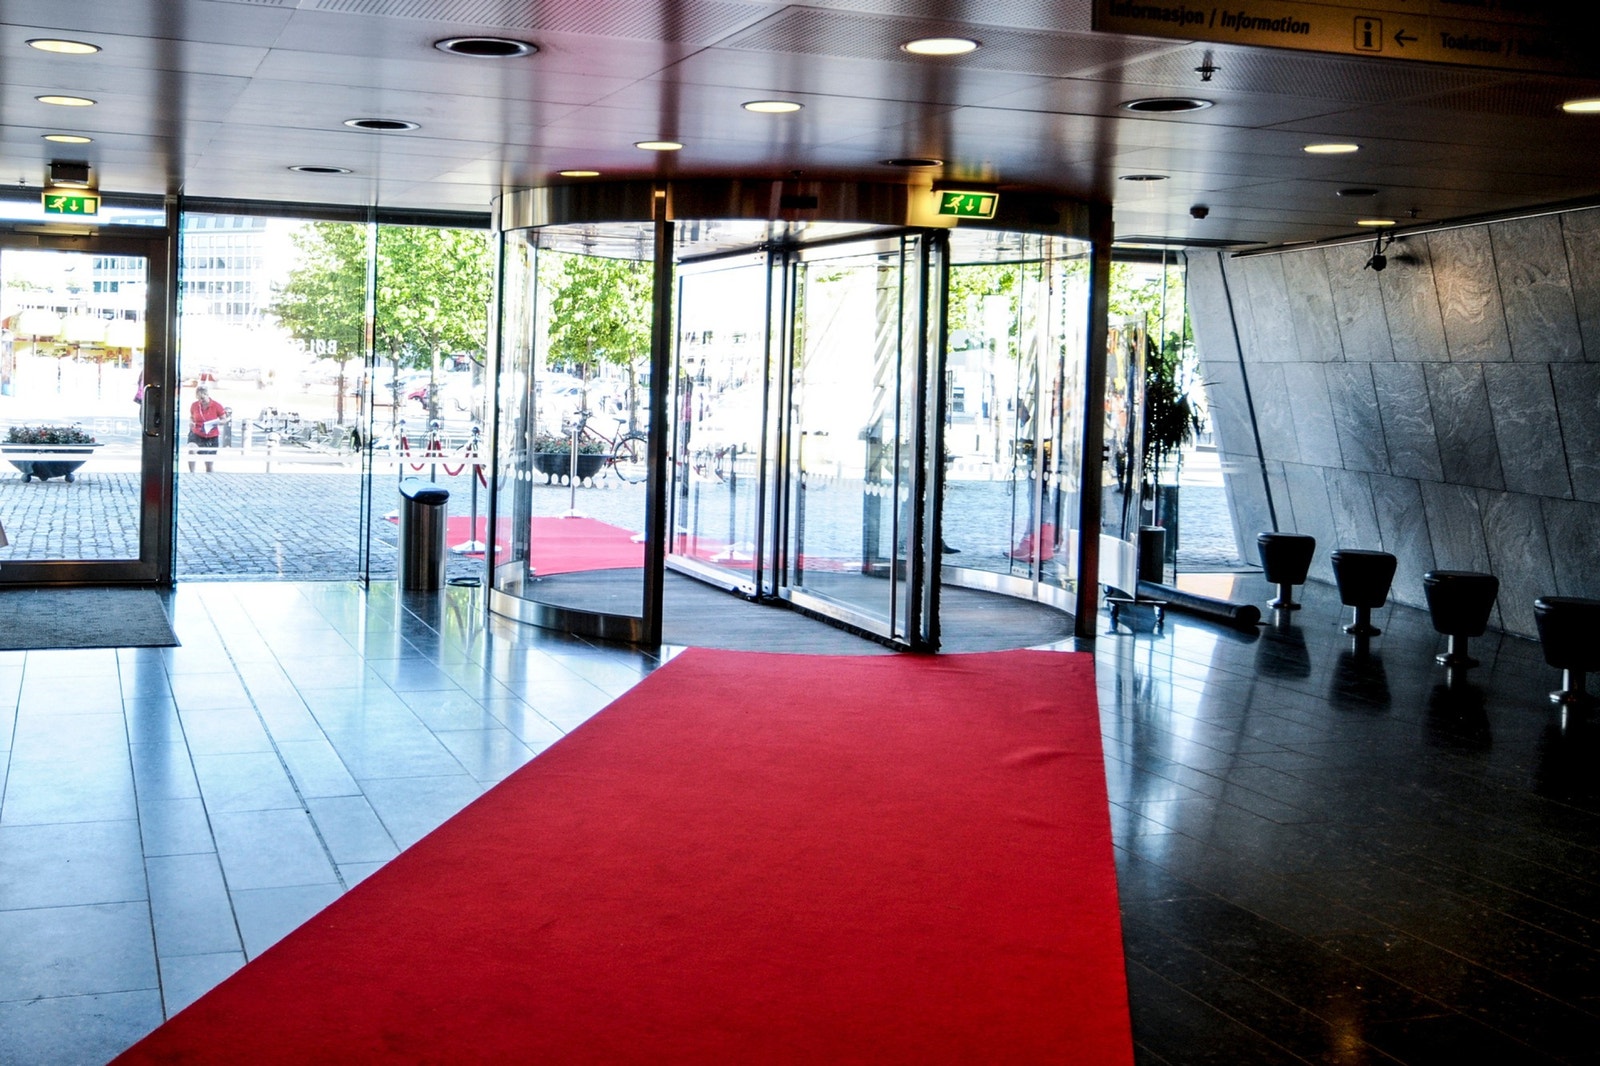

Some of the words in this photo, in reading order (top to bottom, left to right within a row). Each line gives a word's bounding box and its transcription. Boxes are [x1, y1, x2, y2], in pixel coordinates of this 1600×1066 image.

[1110, 0, 1204, 26] Informasjon
[1209, 8, 1217, 29] /
[1221, 11, 1310, 34] Information
